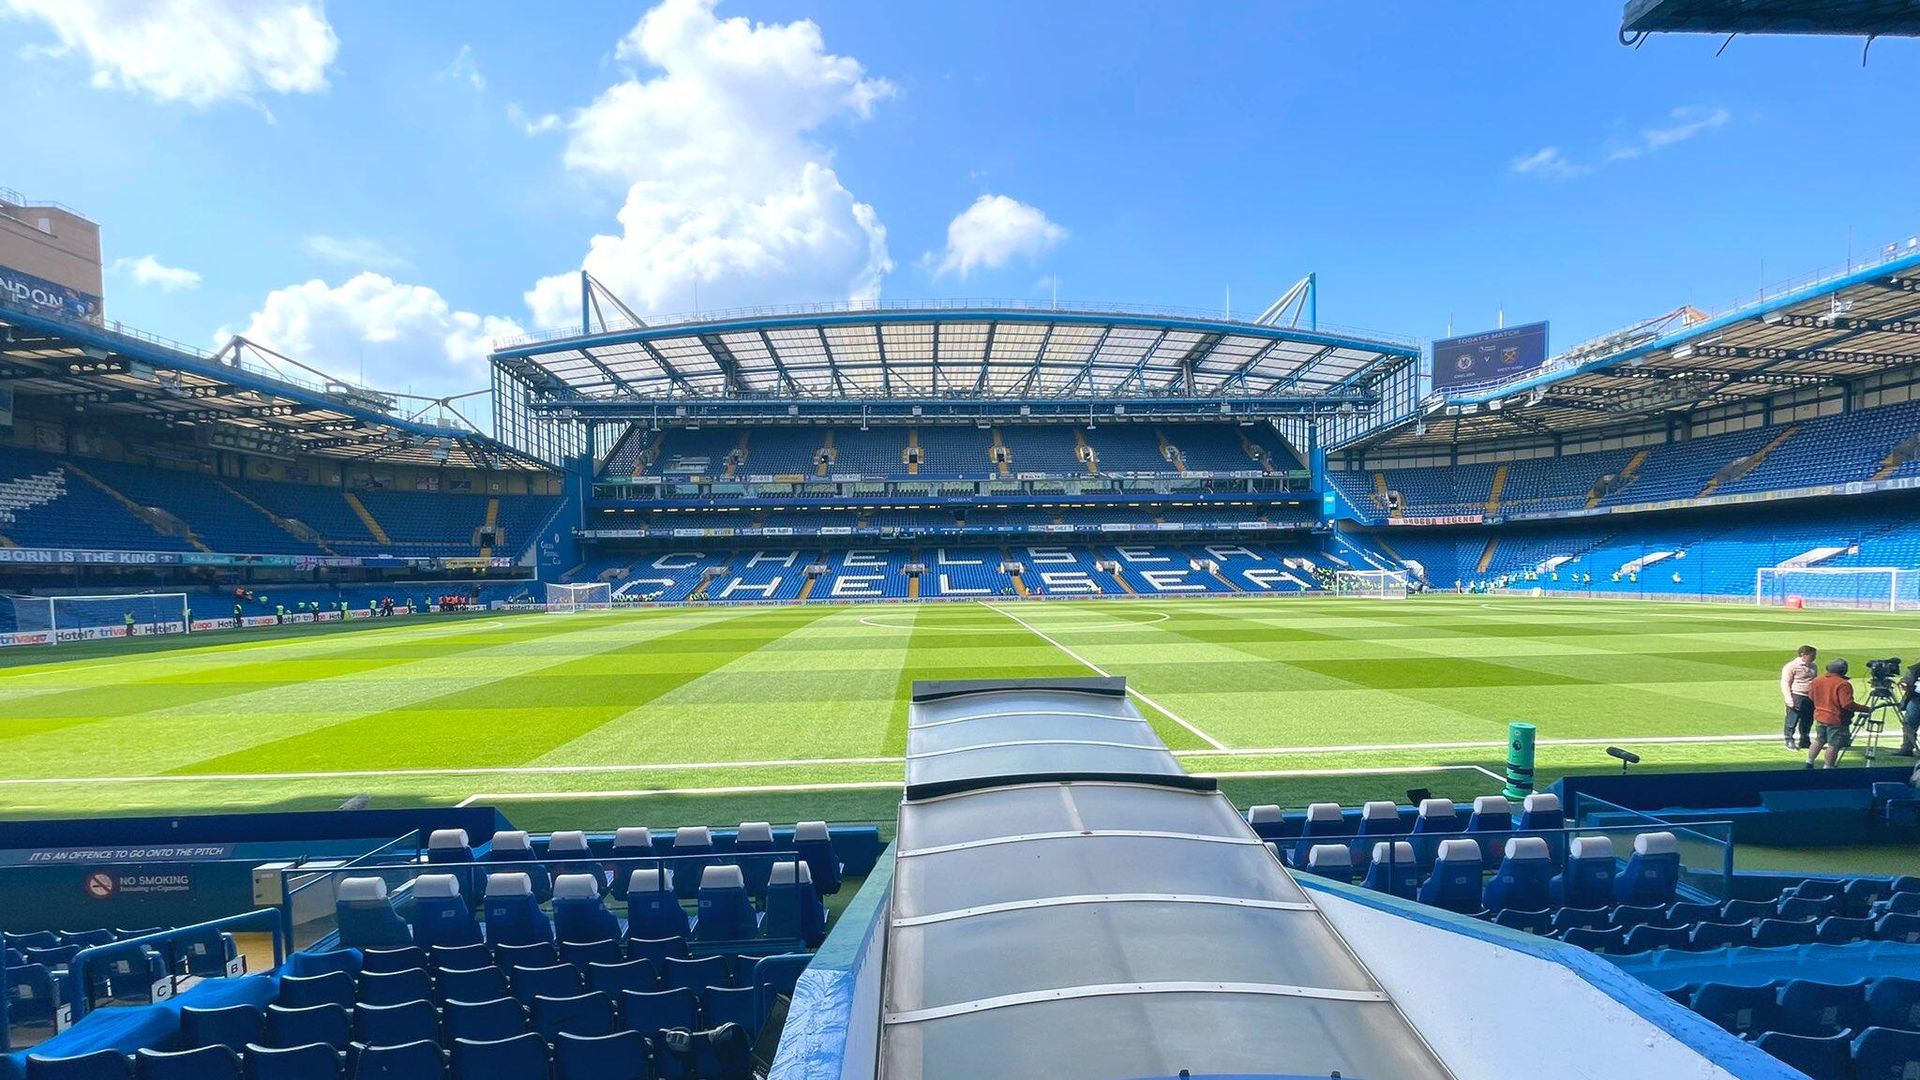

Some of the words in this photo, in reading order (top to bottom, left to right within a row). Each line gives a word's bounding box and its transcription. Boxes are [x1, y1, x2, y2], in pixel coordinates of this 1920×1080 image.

[1457, 334, 1489, 345] TODAY'S
[1491, 329, 1520, 339] MATCH
[0, 551, 50, 562] BORN
[58, 551, 75, 563] IS
[83, 552, 114, 563] THE
[119, 552, 156, 564] KING
[57, 629, 95, 641] Hotel?
[30, 852, 41, 861] IT
[41, 852, 52, 861] IS
[52, 852, 68, 860] AN
[69, 850, 113, 860] OFFENCE
[115, 850, 128, 858] TO
[129, 849, 145, 858] GO
[146, 848, 174, 858] ONTO
[175, 848, 192, 857] THE
[194, 847, 224, 856] PITCH
[119, 876, 136, 885] NO
[138, 875, 189, 885] SMOKING
[231, 964, 238, 974] B
[157, 985, 167, 997] C
